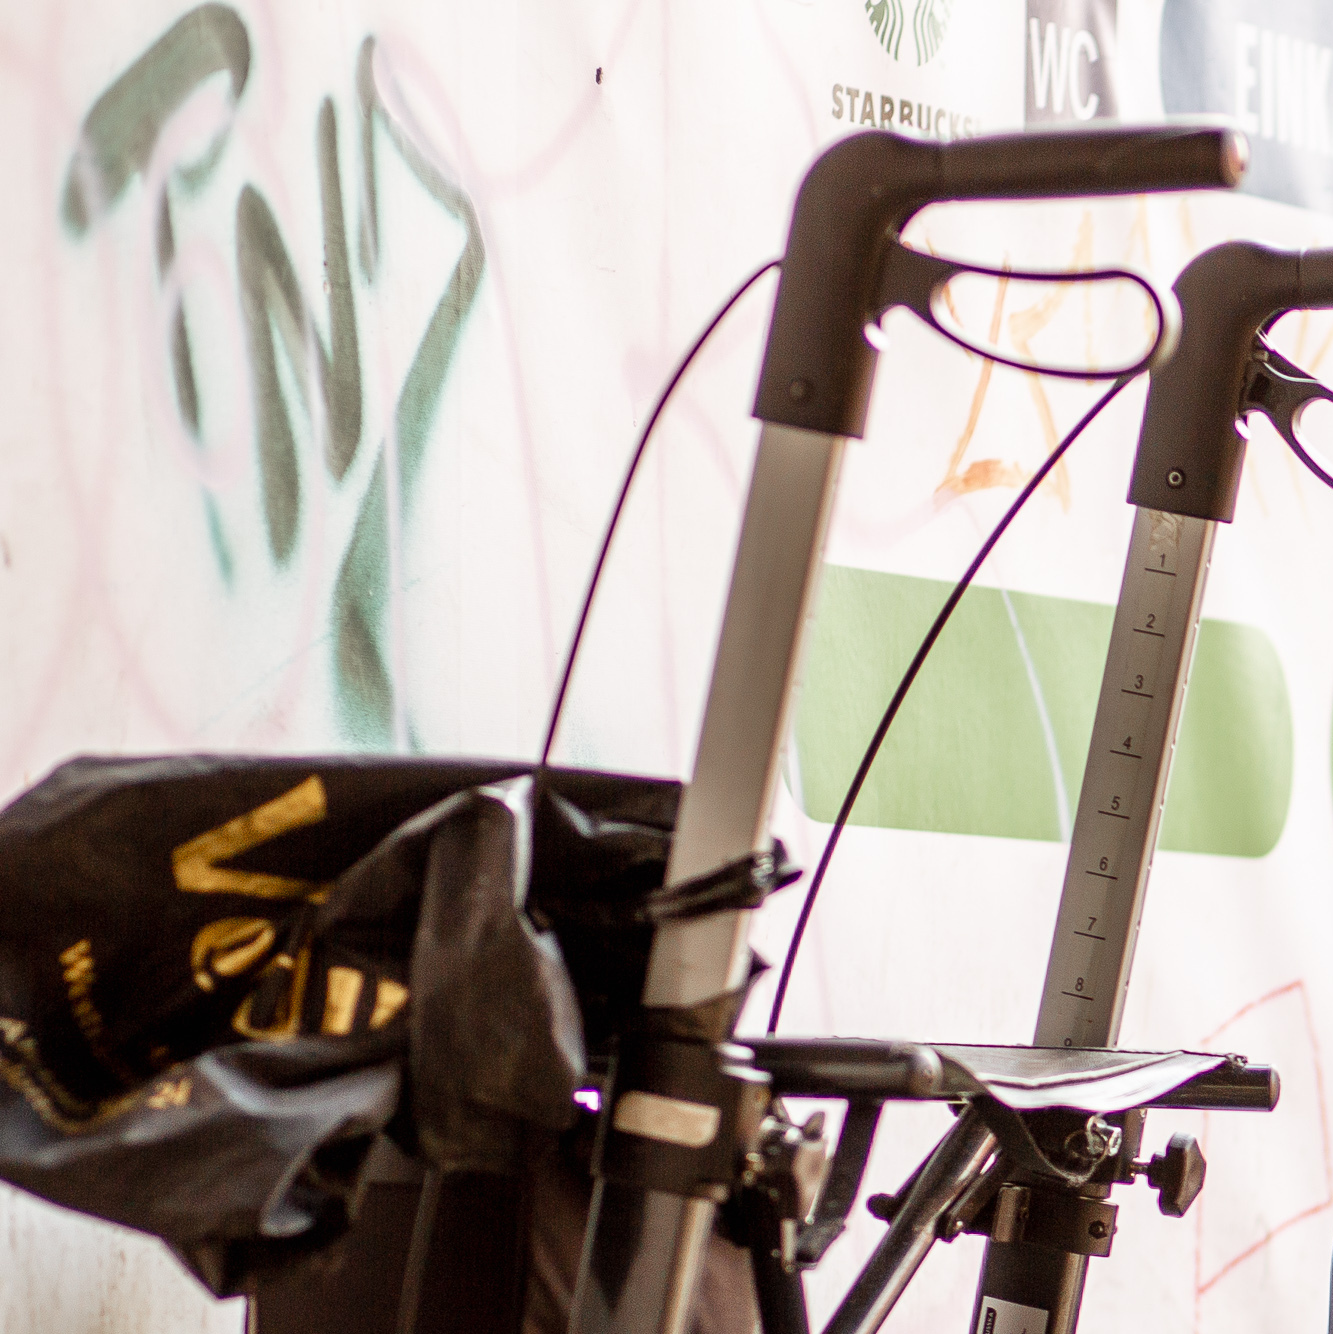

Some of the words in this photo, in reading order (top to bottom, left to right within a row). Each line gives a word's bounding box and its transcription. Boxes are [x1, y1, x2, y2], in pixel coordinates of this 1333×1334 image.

[1029, 17, 1100, 121] WC
[1158, 553, 1167, 567] 1
[1146, 613, 1156, 628] 2
[1134, 674, 1144, 689] 3
[1122, 736, 1132, 750] 4
[1110, 796, 1121, 811] 5
[1099, 856, 1109, 871] 6
[1087, 917, 1098, 931] 7
[1075, 977, 1085, 992] 8
